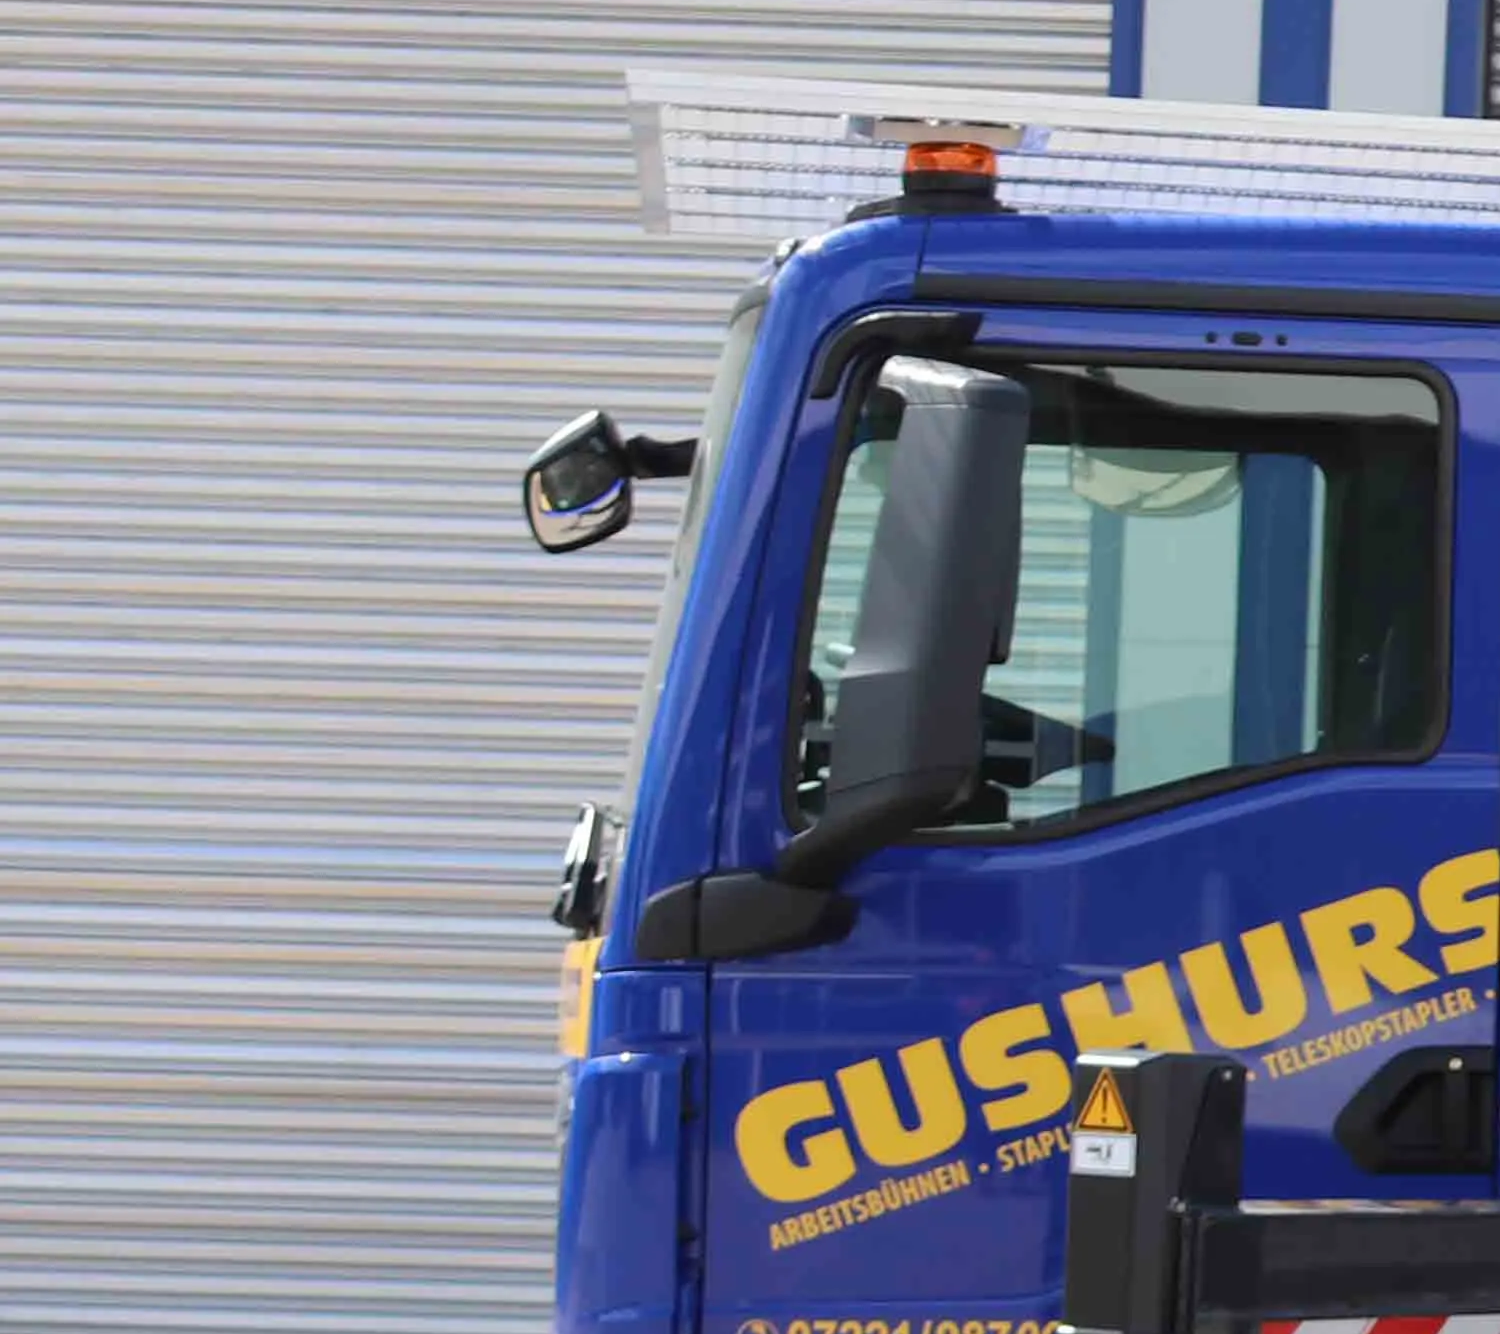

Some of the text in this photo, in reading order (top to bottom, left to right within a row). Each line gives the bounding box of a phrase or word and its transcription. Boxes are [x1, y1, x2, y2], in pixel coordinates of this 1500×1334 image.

[769, 1158, 972, 1251] ARBEITSBÜHNEN
[996, 1123, 1072, 1173] STAPL
[1262, 986, 1478, 1080] TELESKOPSTAPLER
